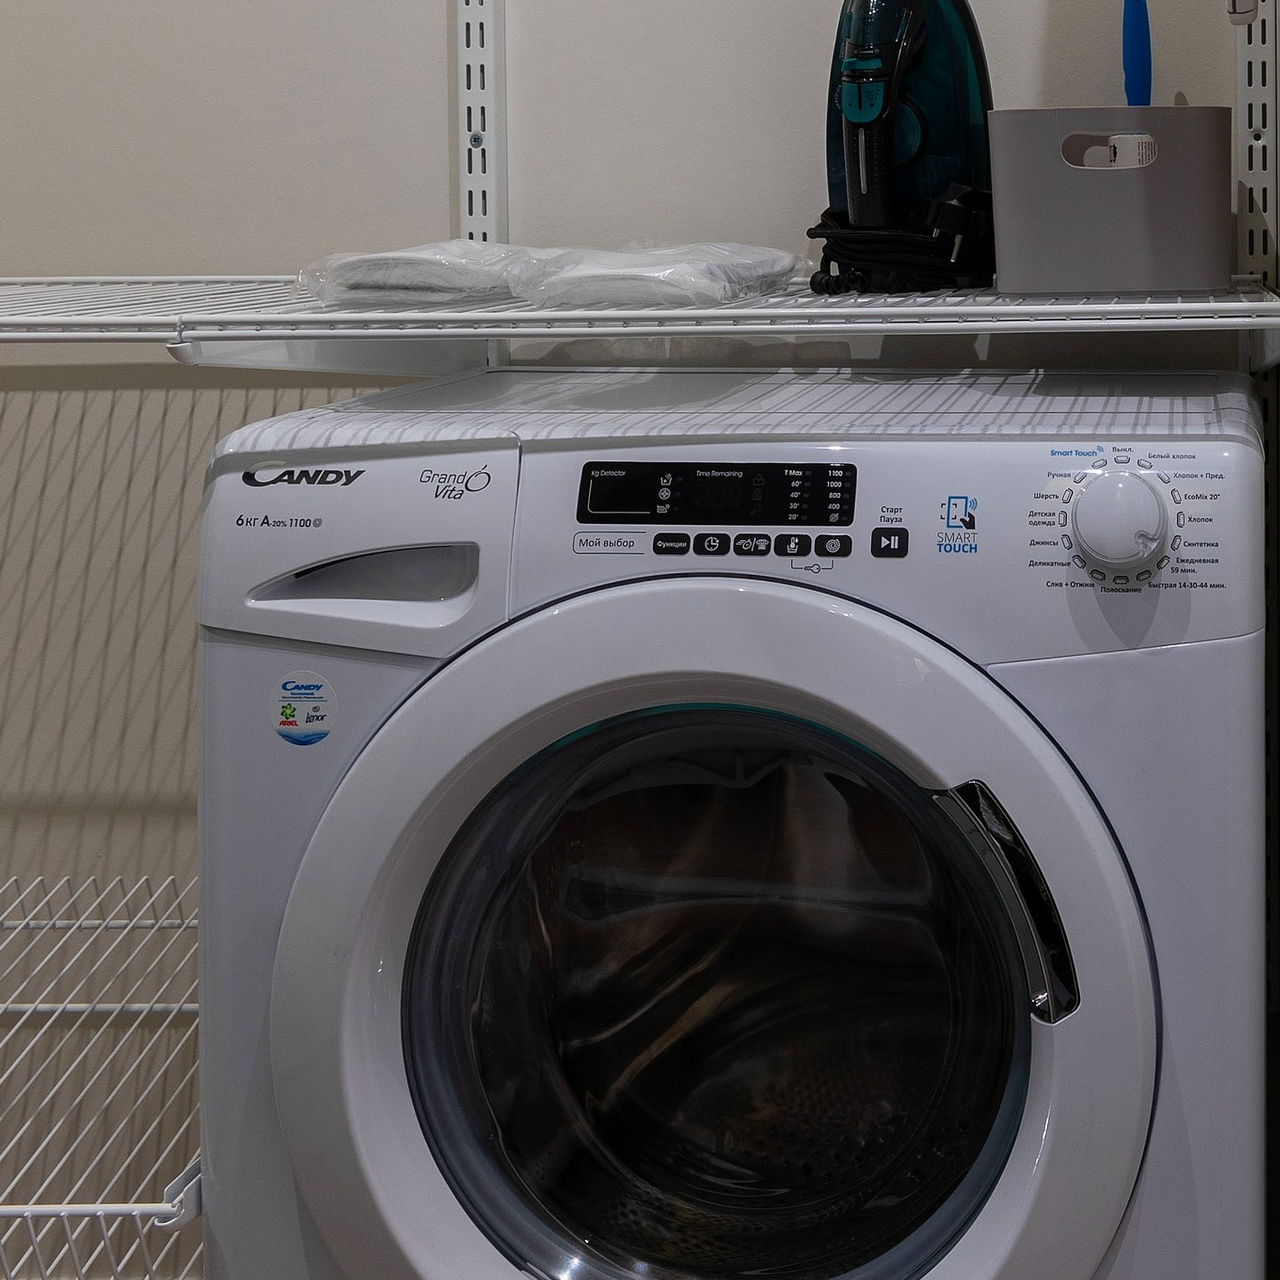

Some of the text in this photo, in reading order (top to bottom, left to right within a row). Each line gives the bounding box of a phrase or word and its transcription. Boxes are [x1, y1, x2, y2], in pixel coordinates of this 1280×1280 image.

[1050, 449, 1097, 457] Smart Touch
[242, 460, 366, 487] CANDY
[711, 470, 743, 478] Remaining
[434, 484, 464, 499] Vita
[881, 506, 903, 514] Старт
[236, 514, 244, 526] 6
[289, 518, 312, 528] 1100
[880, 516, 903, 524] Пауза
[937, 532, 978, 543] SMART
[579, 538, 635, 549] Мой выбор
[657, 540, 687, 549] Функции
[937, 543, 978, 553] TOUCH
[1029, 560, 1071, 568] Деликатные
[1176, 557, 1219, 565] Ежедневная
[1100, 586, 1142, 594] Полоскание
[305, 712, 327, 724] Lenor
